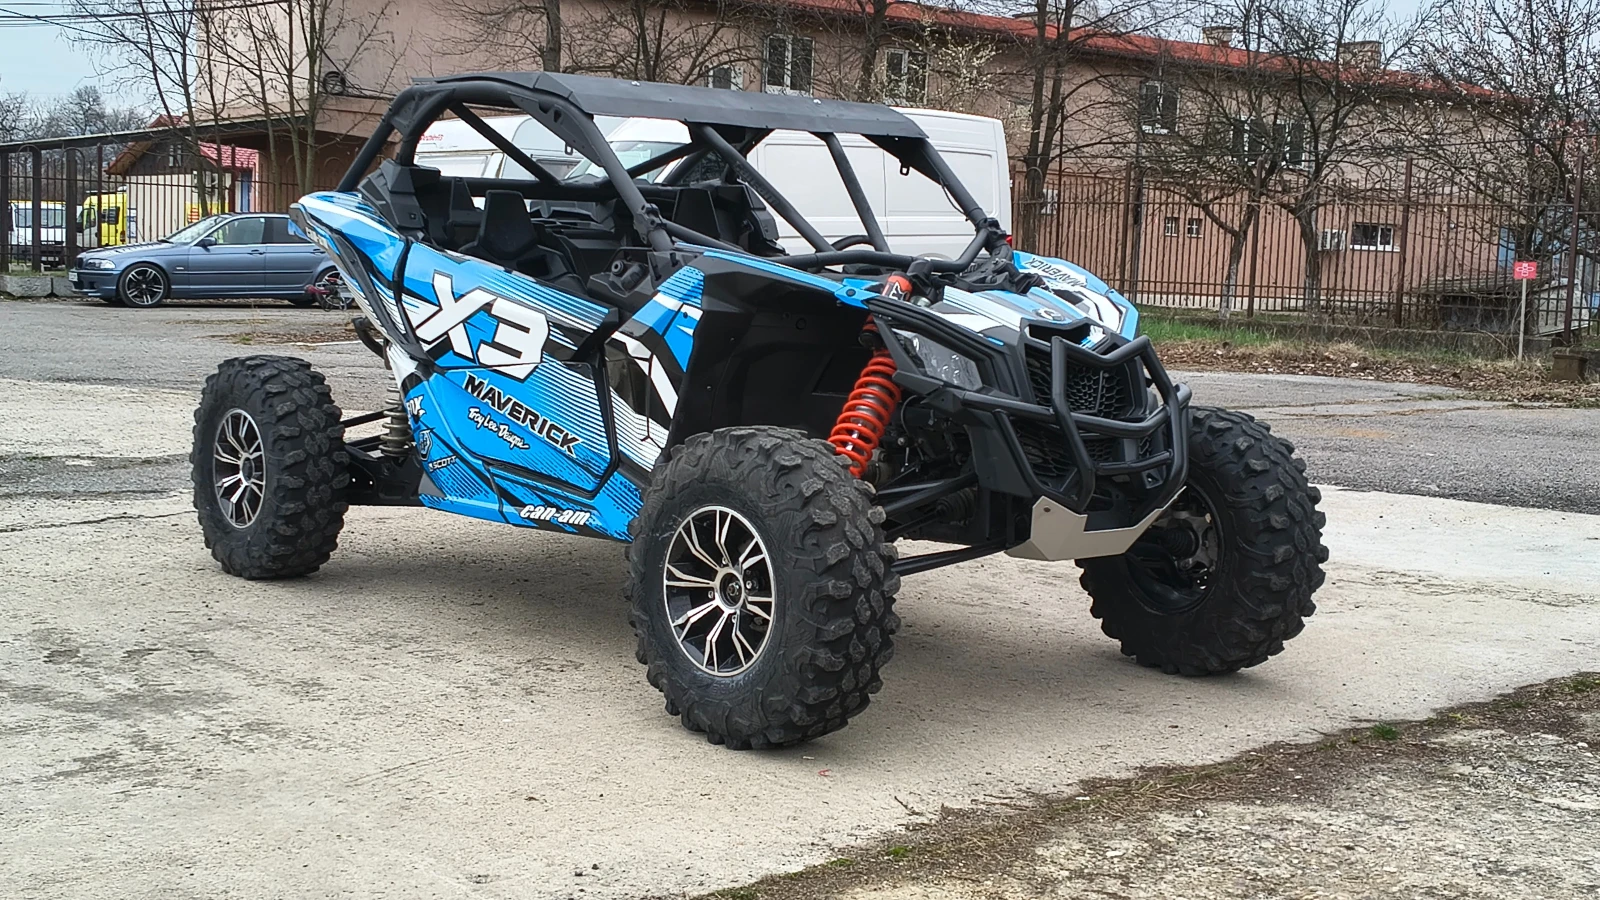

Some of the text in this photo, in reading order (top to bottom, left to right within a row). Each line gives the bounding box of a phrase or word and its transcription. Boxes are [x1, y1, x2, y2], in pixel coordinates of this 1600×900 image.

[1024, 257, 1085, 288] MAVERICK
[414, 270, 550, 382] X3
[463, 372, 581, 457] MAVERICK
[468, 407, 530, 449] Troy Lee Designs
[432, 455, 457, 469] SCOTT
[520, 504, 591, 526] can-am
